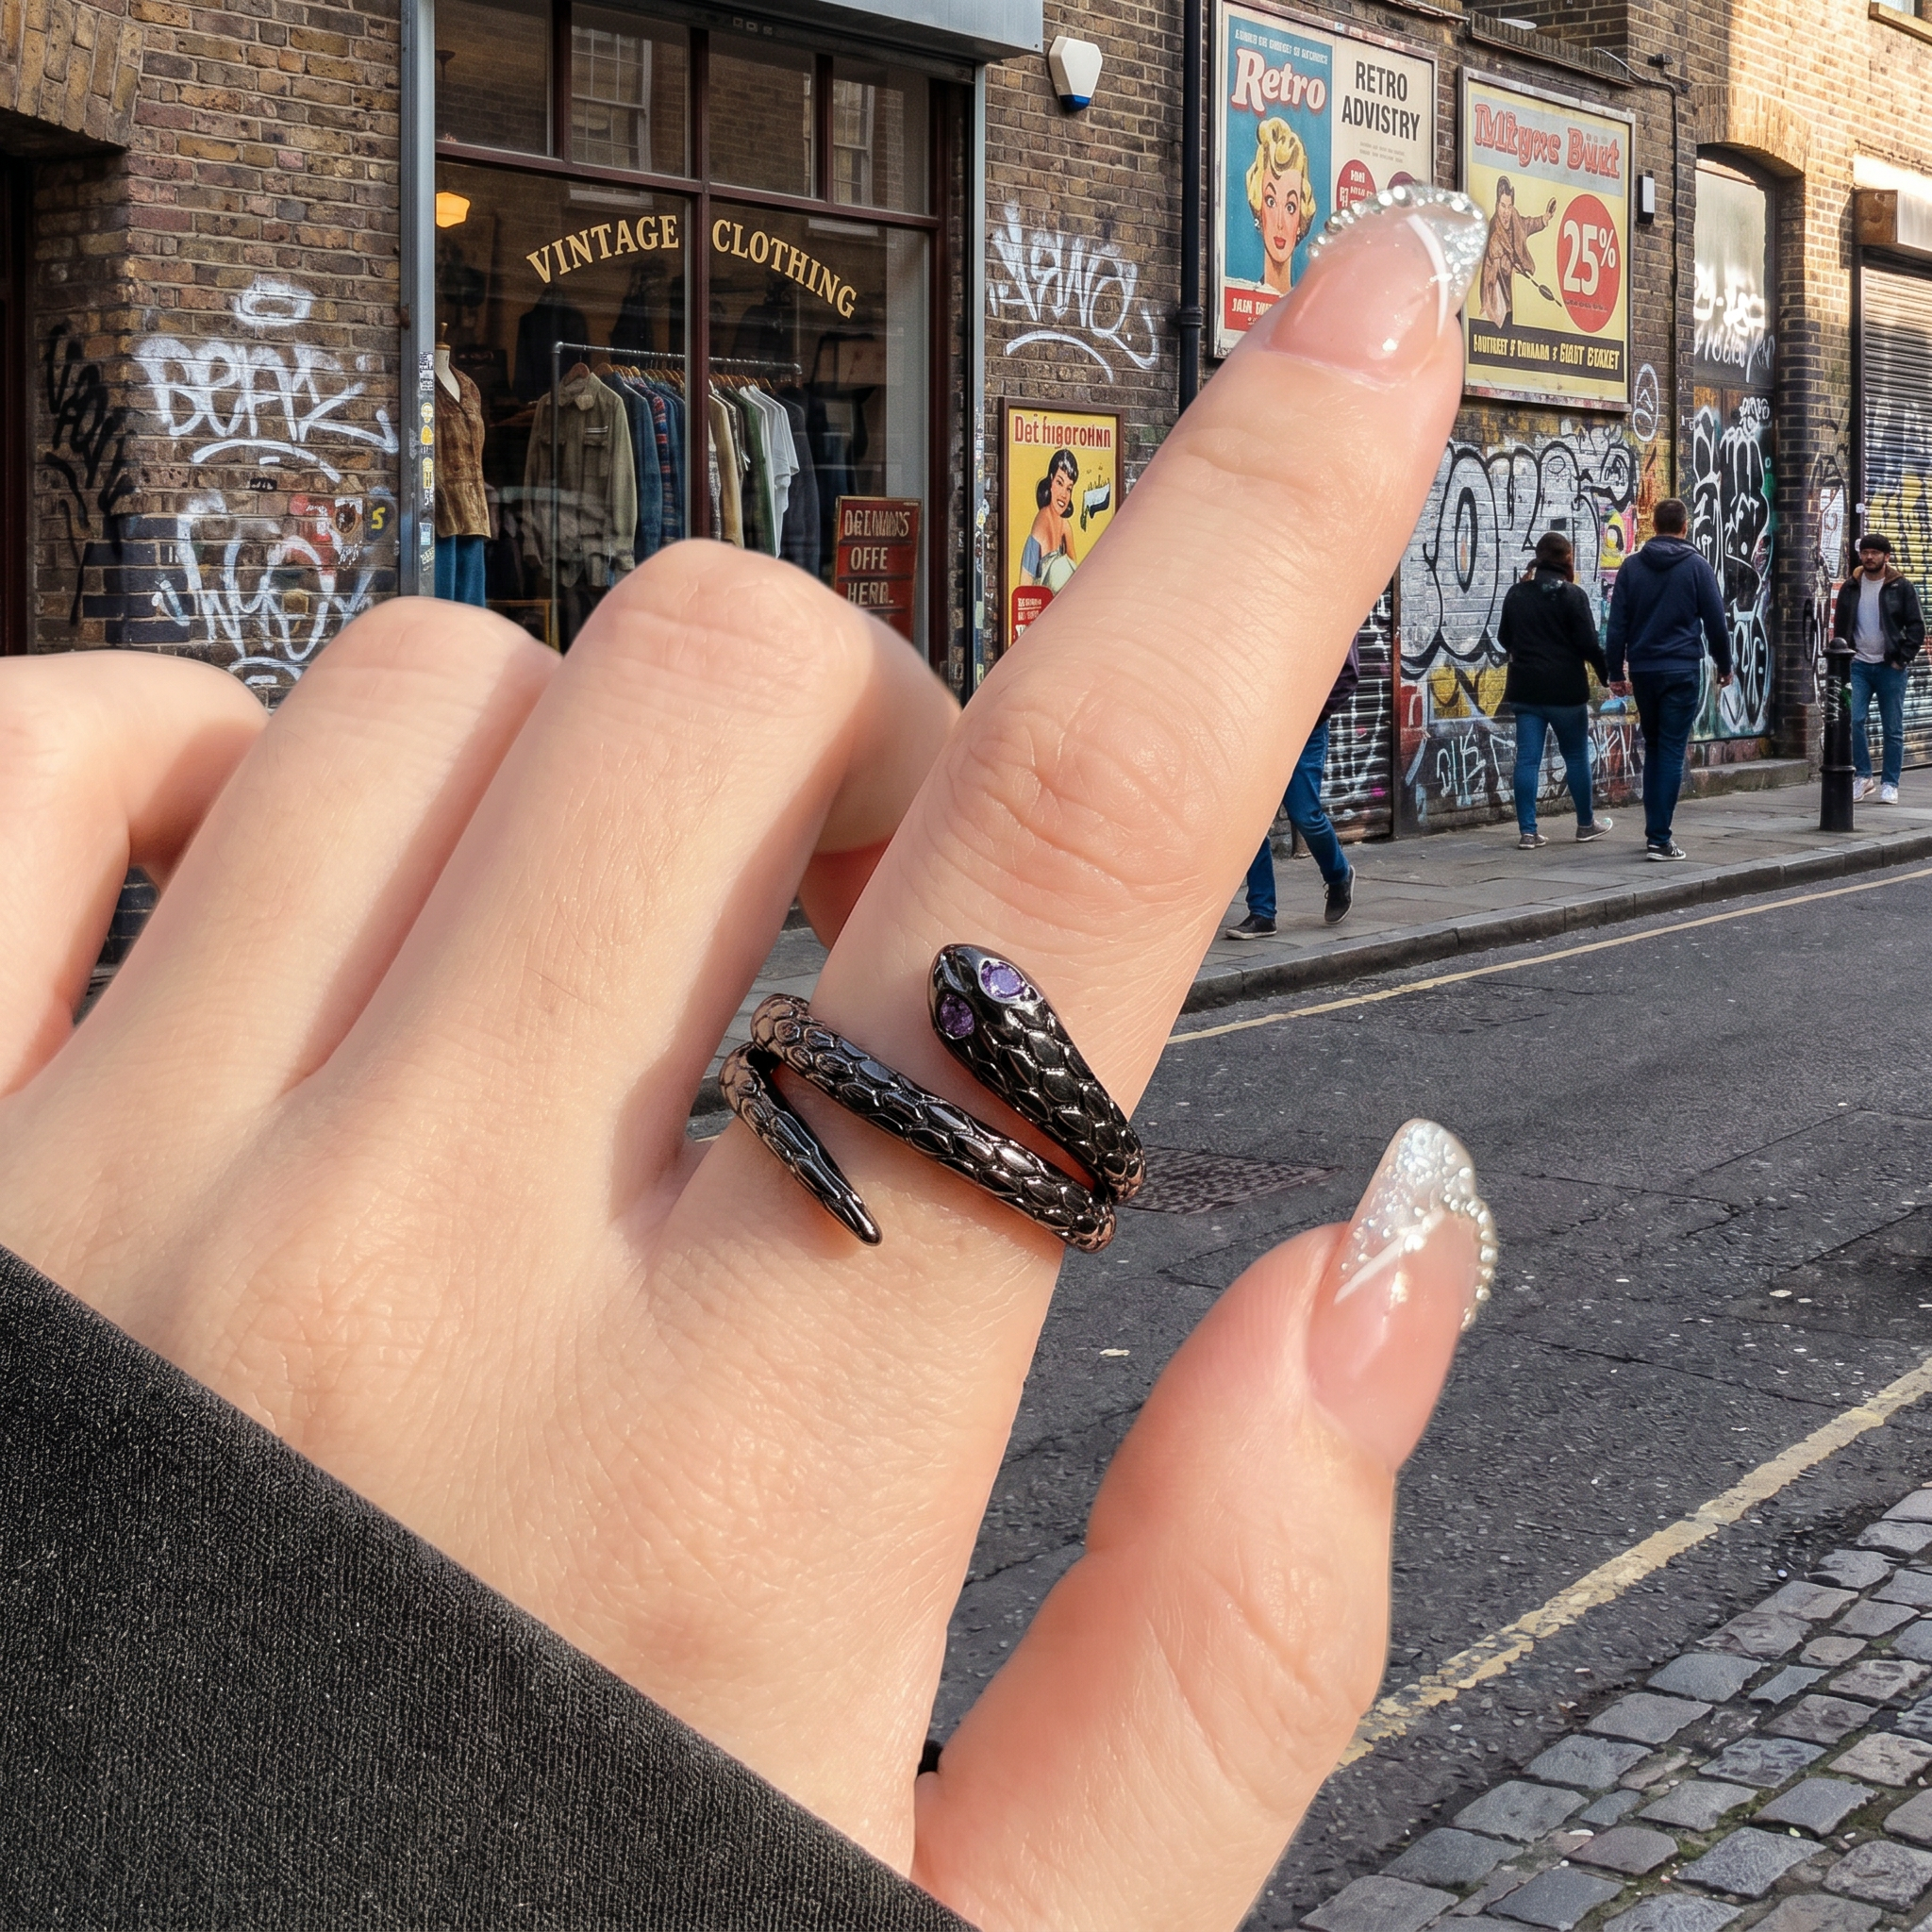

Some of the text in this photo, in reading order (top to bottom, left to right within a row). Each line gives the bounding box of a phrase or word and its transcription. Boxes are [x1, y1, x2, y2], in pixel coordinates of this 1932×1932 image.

[1231, 47, 1326, 116] Retro
[1356, 60, 1407, 102] RETRO
[1341, 95, 1421, 142] ADVISTRY
[525, 215, 679, 284] VINTAGE
[712, 219, 858, 319] CLOTHING
[1563, 219, 1616, 296] 25%
[850, 547, 889, 570] OFFE
